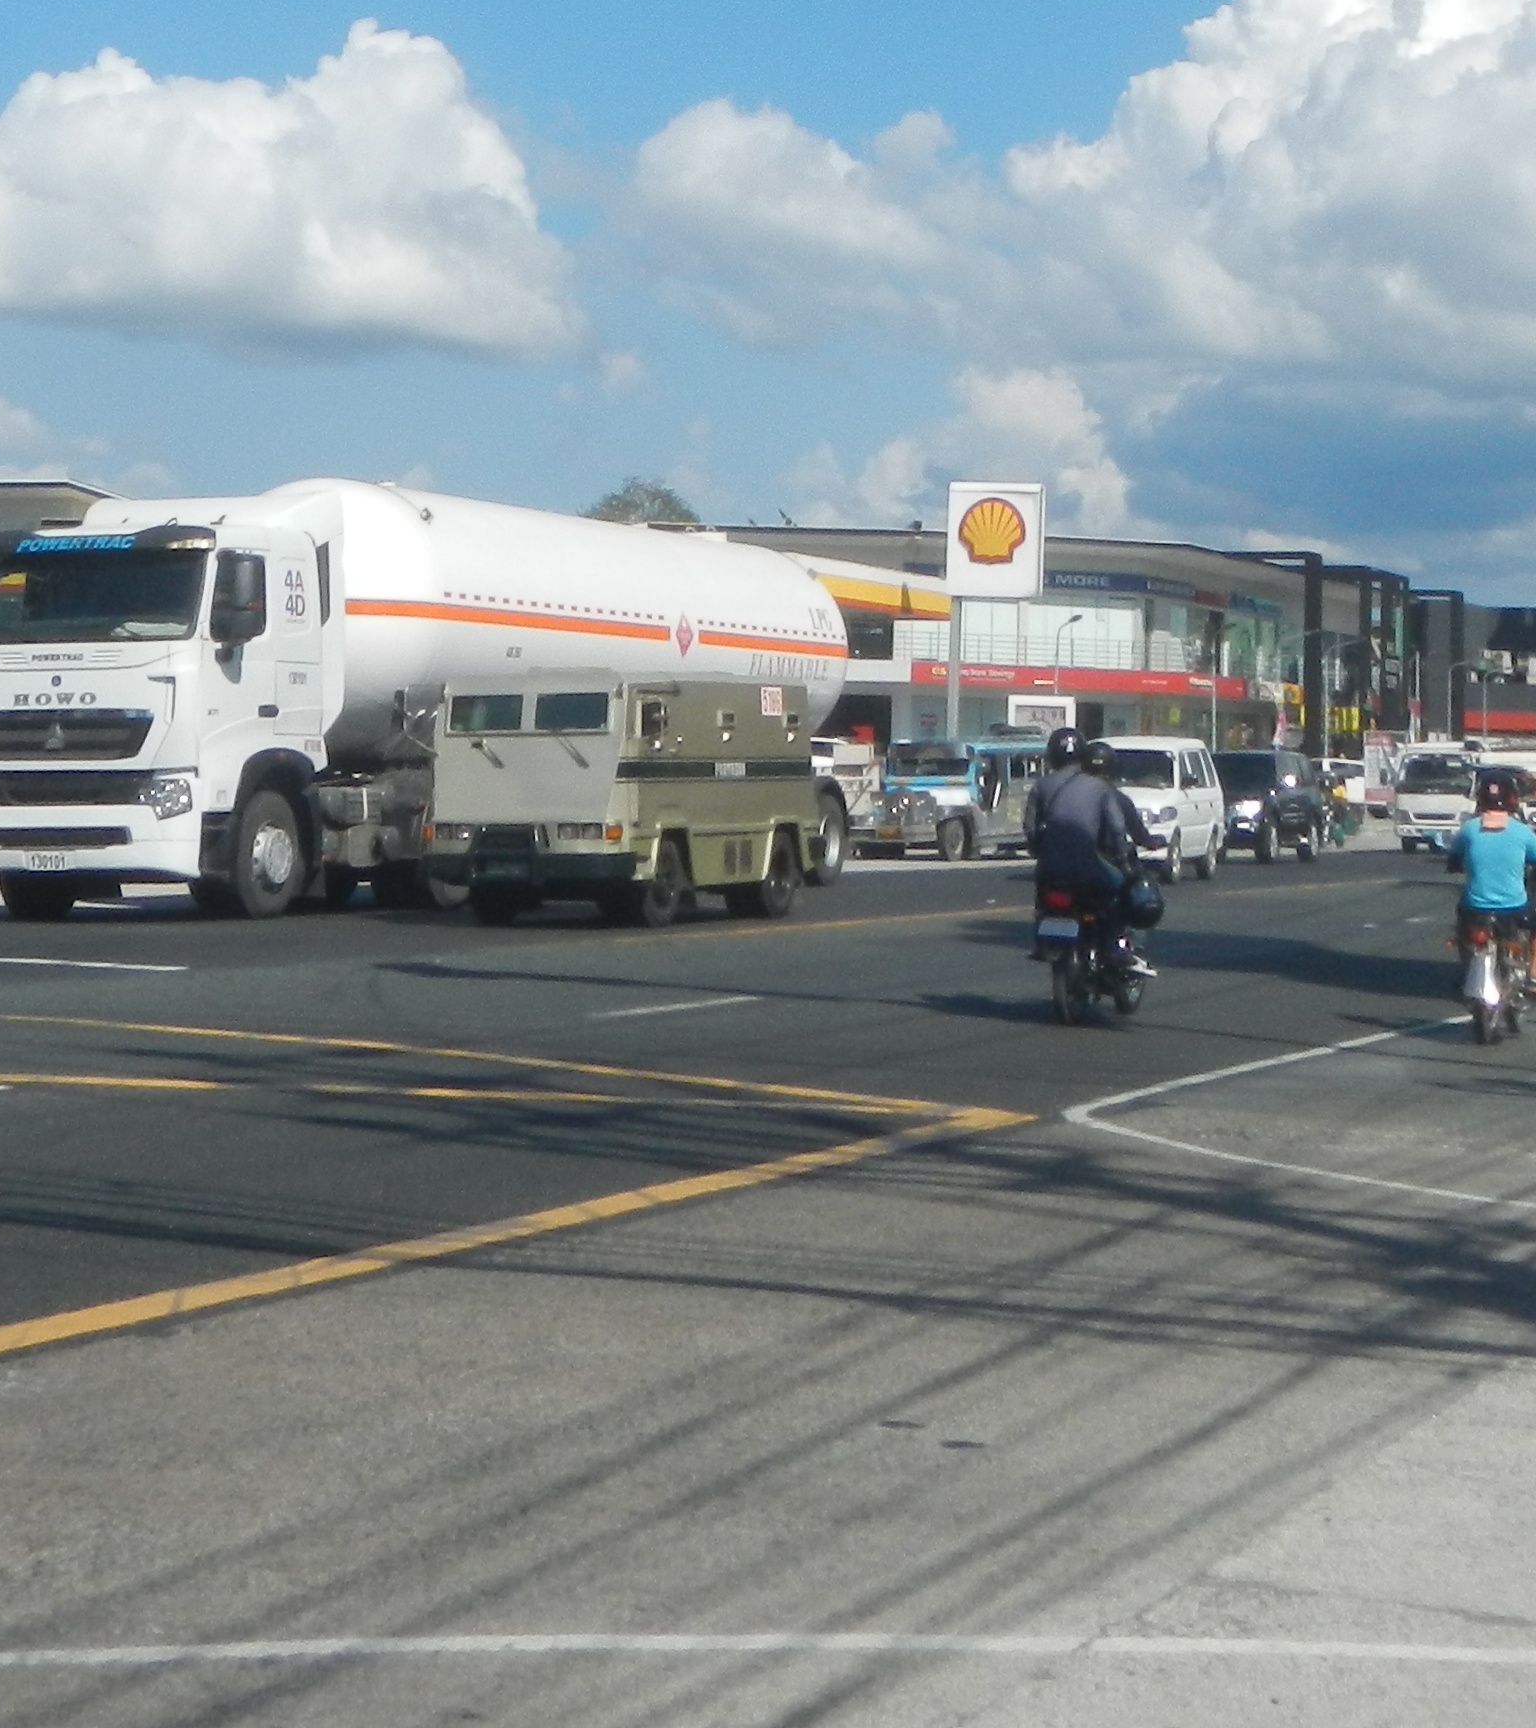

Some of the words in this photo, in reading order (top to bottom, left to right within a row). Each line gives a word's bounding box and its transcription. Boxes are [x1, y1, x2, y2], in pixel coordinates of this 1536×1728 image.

[16, 535, 137, 555] POWERTRAC
[283, 570, 305, 593] 4A
[1054, 573, 1110, 588] MORE
[284, 593, 307, 617] 4D
[31, 653, 84, 662] POWERTRAC
[749, 652, 829, 682] FLAMMABLE
[13, 692, 97, 706] HOWO
[30, 855, 66, 870] 130101
